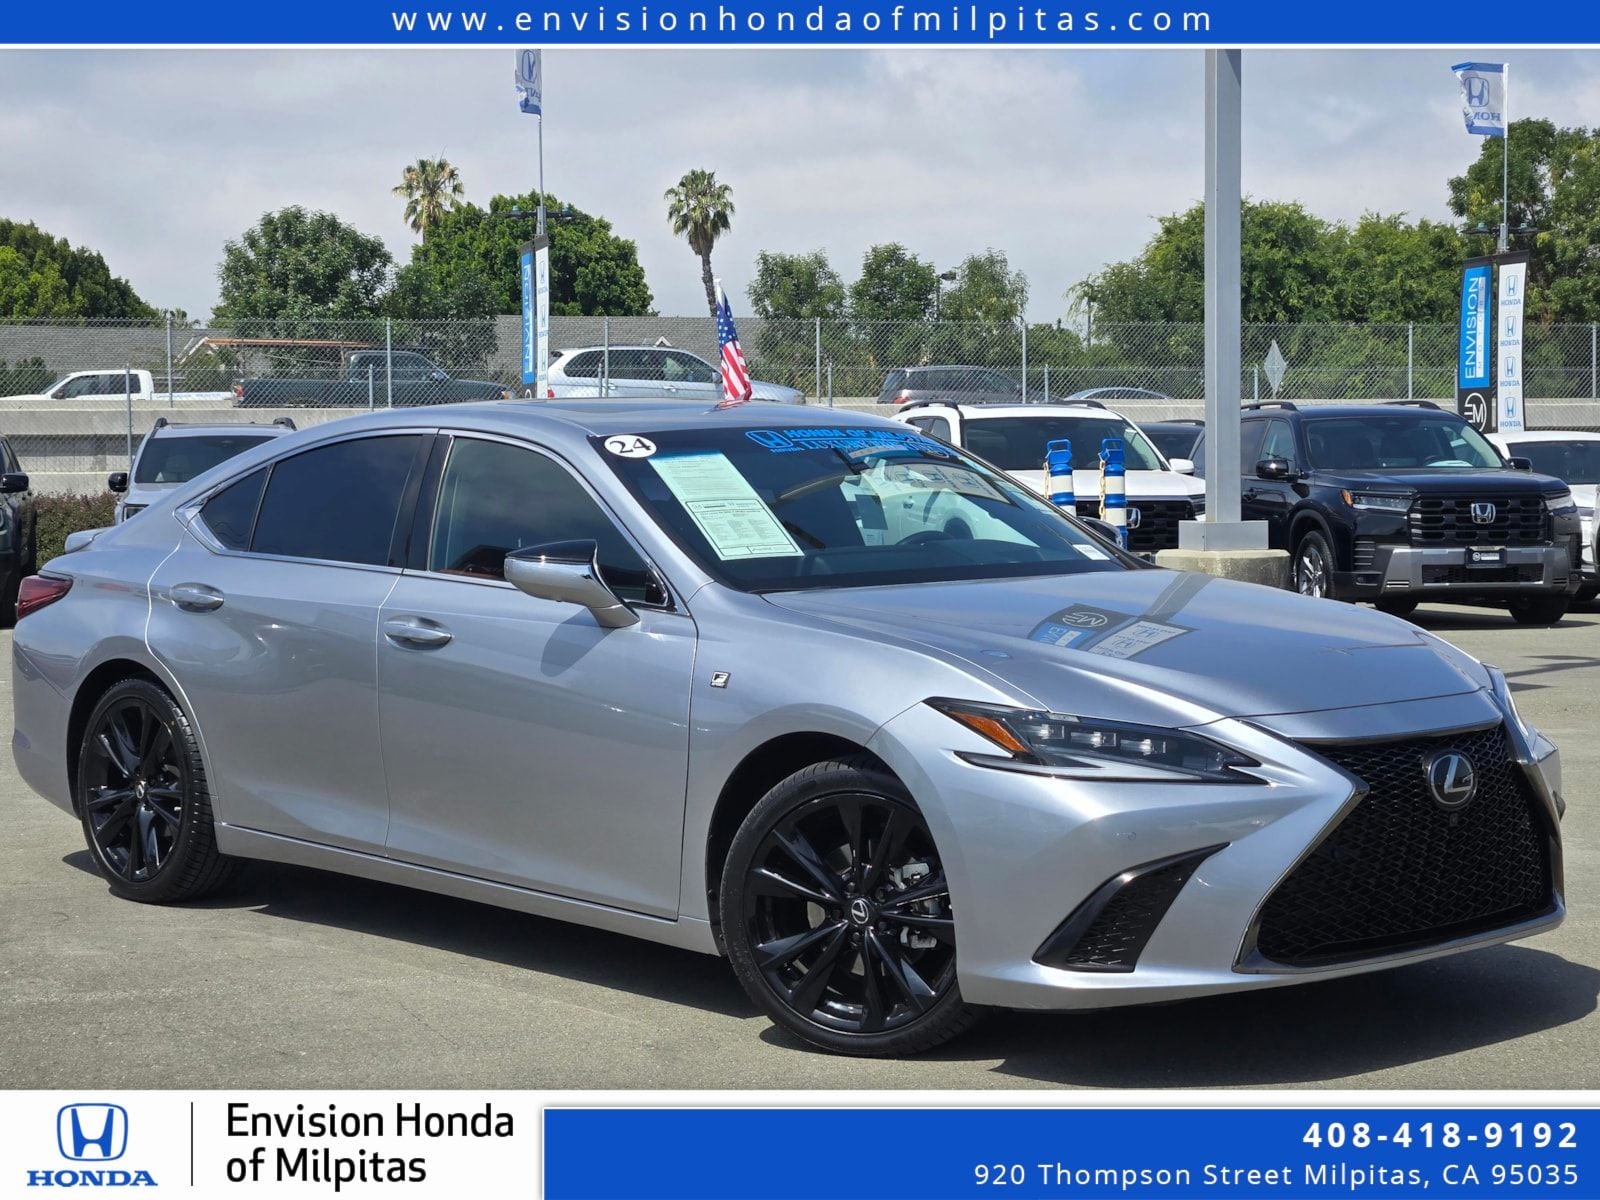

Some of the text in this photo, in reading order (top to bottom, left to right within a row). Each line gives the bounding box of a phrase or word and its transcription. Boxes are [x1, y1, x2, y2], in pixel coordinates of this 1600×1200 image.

[1501, 298, 1521, 306] HONDA
[1465, 277, 1479, 379] ENVISION
[1500, 339, 1520, 347] HONDA
[1500, 420, 1521, 428] HONDA
[784, 429, 846, 440] HONDA
[846, 430, 868, 439] OF
[617, 438, 652, 455] 24
